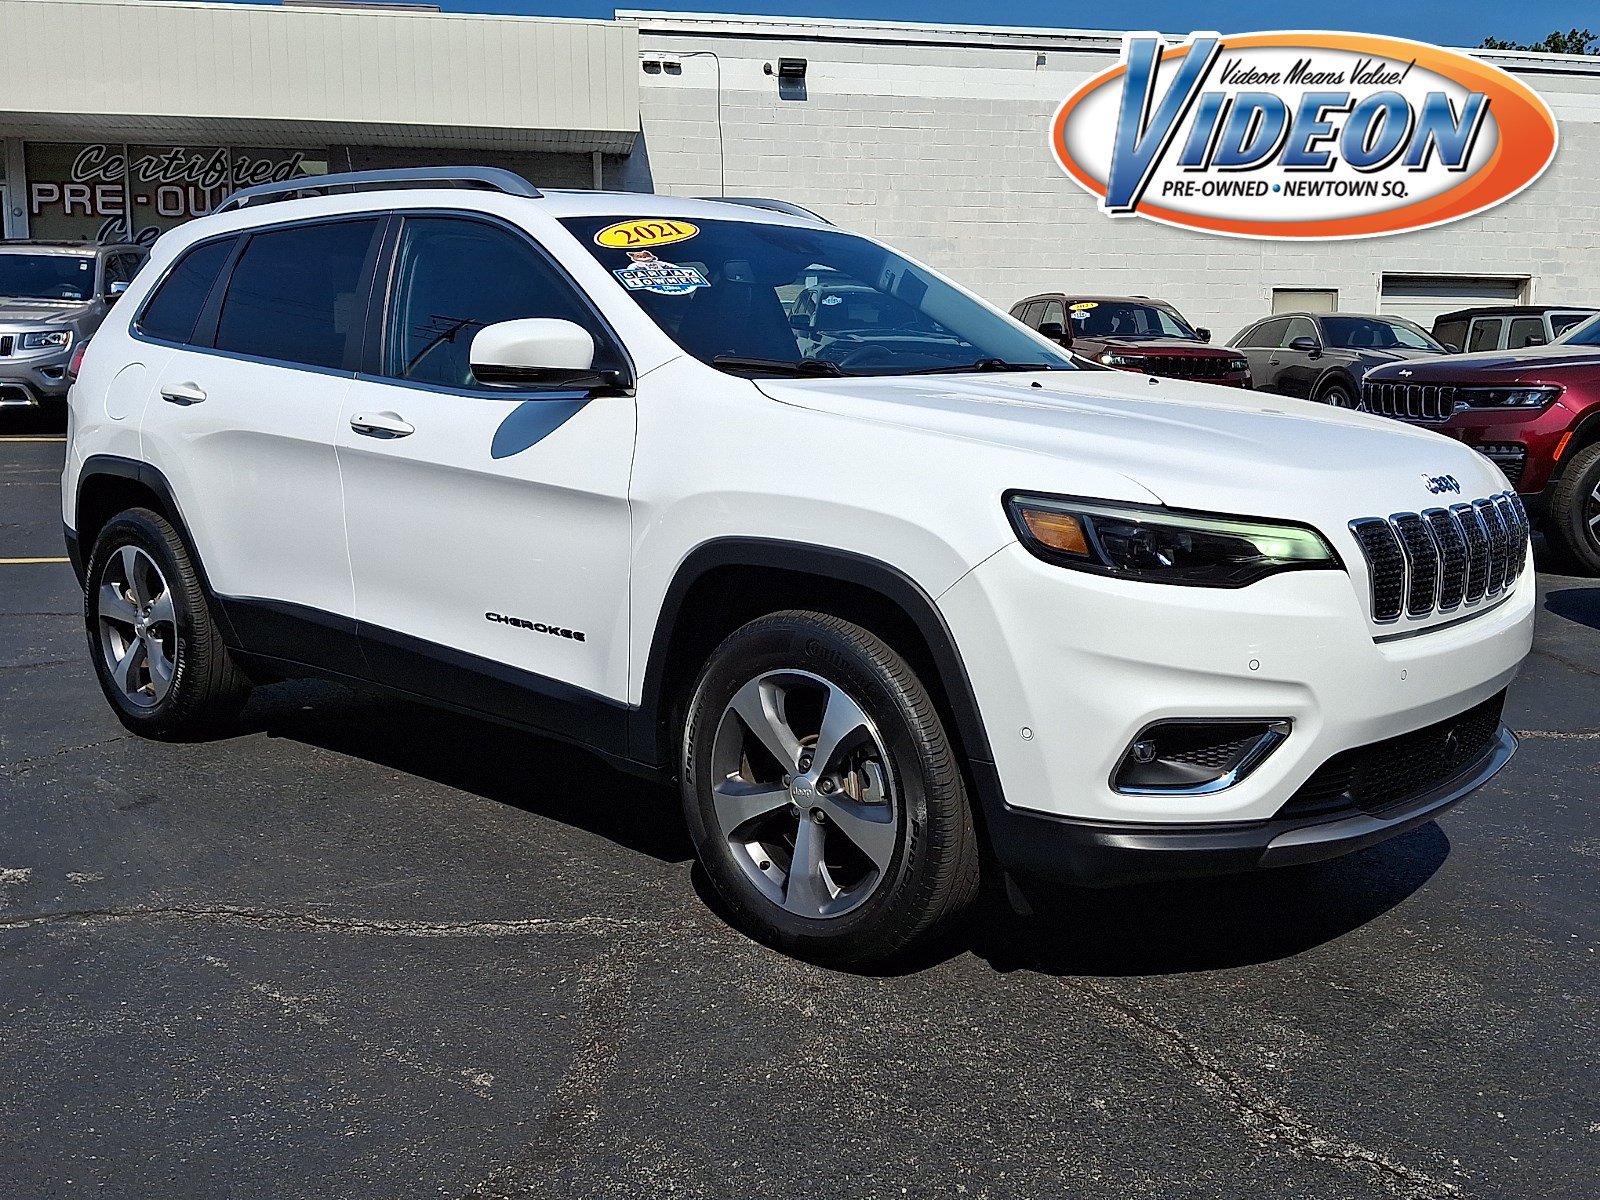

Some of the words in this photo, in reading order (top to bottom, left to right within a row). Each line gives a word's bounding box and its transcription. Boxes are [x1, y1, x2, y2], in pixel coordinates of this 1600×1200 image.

[71, 144, 306, 190] Certified
[614, 222, 686, 245] 2021
[1420, 473, 1461, 495] Jeep
[484, 611, 586, 643] CHEROKEE
